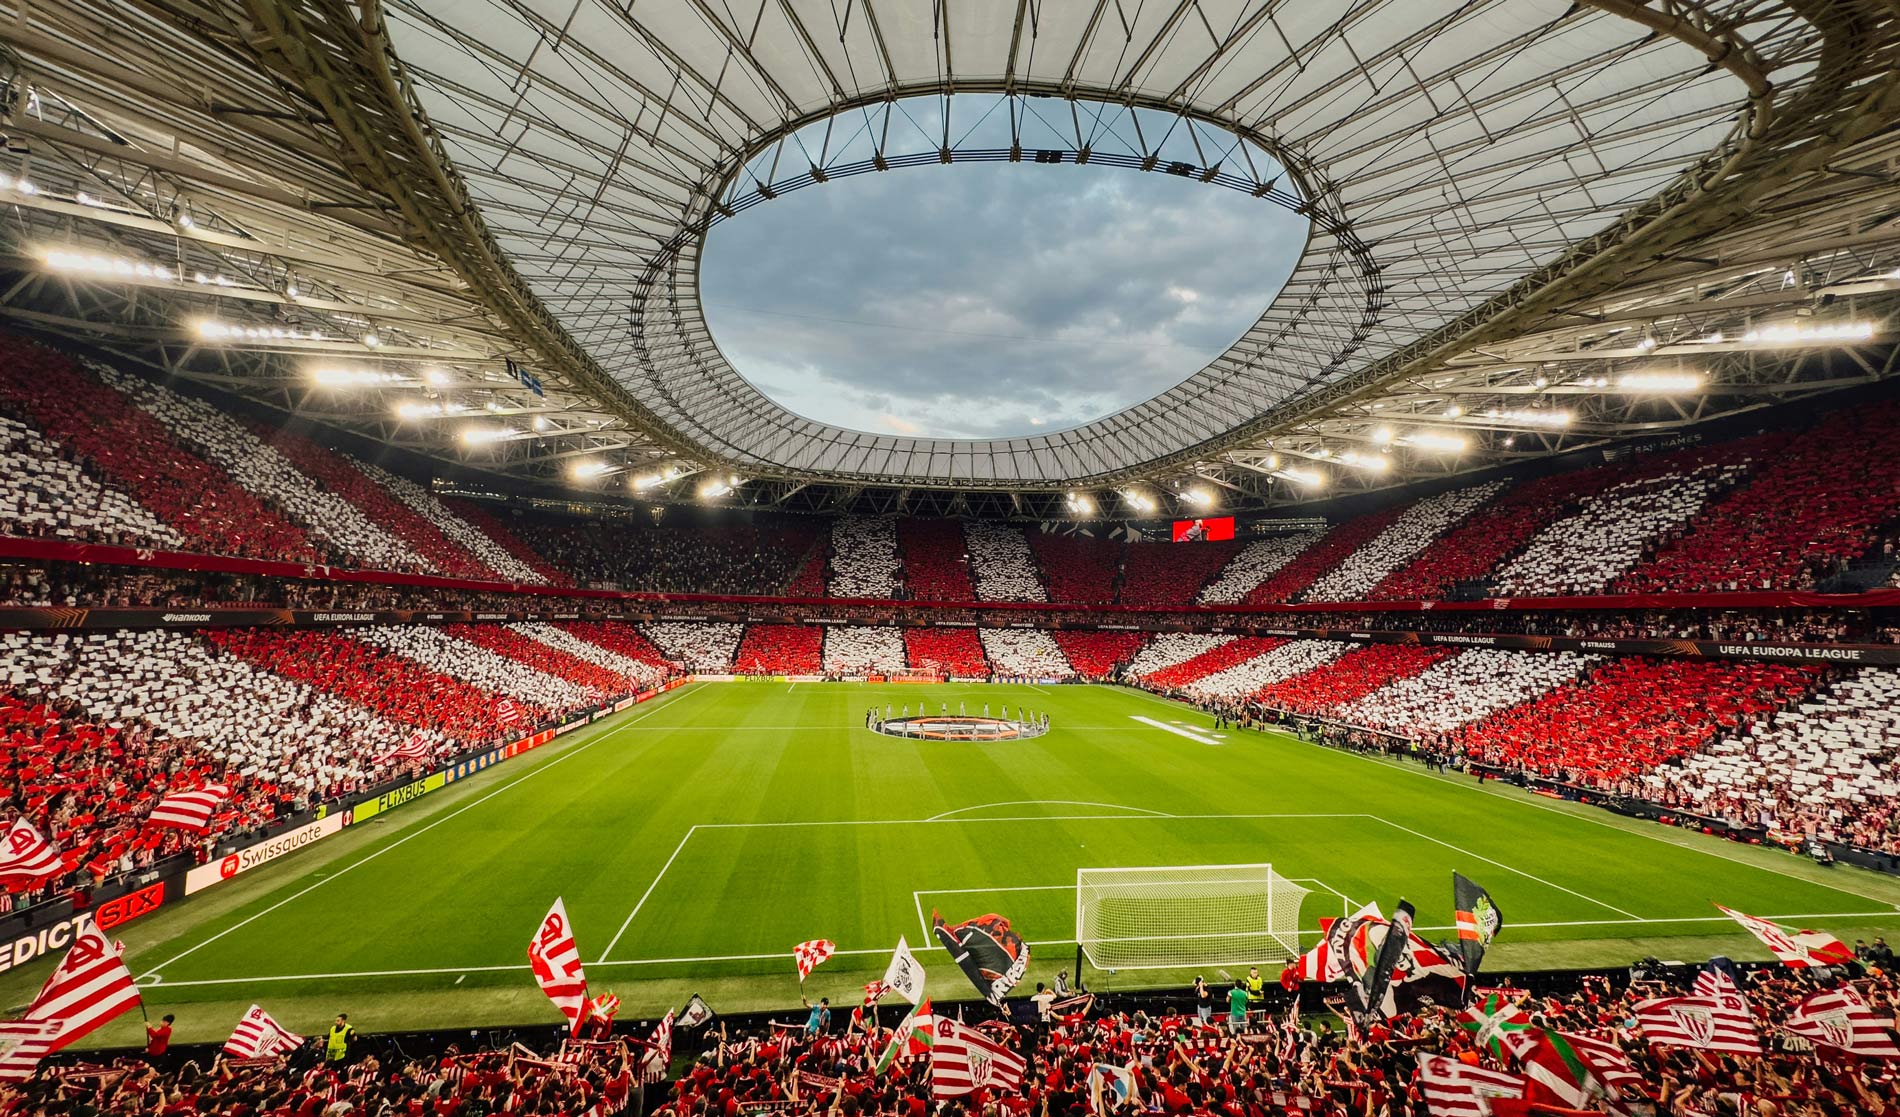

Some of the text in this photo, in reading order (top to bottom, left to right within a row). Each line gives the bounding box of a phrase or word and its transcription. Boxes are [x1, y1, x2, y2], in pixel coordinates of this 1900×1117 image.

[313, 613, 375, 621] UEFA EUROPA LEAGUE
[1447, 635, 1471, 643] EUROPA
[1471, 636, 1495, 644] LEAGUE
[1587, 641, 1616, 649] STRAUSS
[1719, 645, 1861, 660] UEFA EUROPA LEAGUE
[241, 826, 322, 870] Swissquote
[102, 888, 157, 927] SIX
